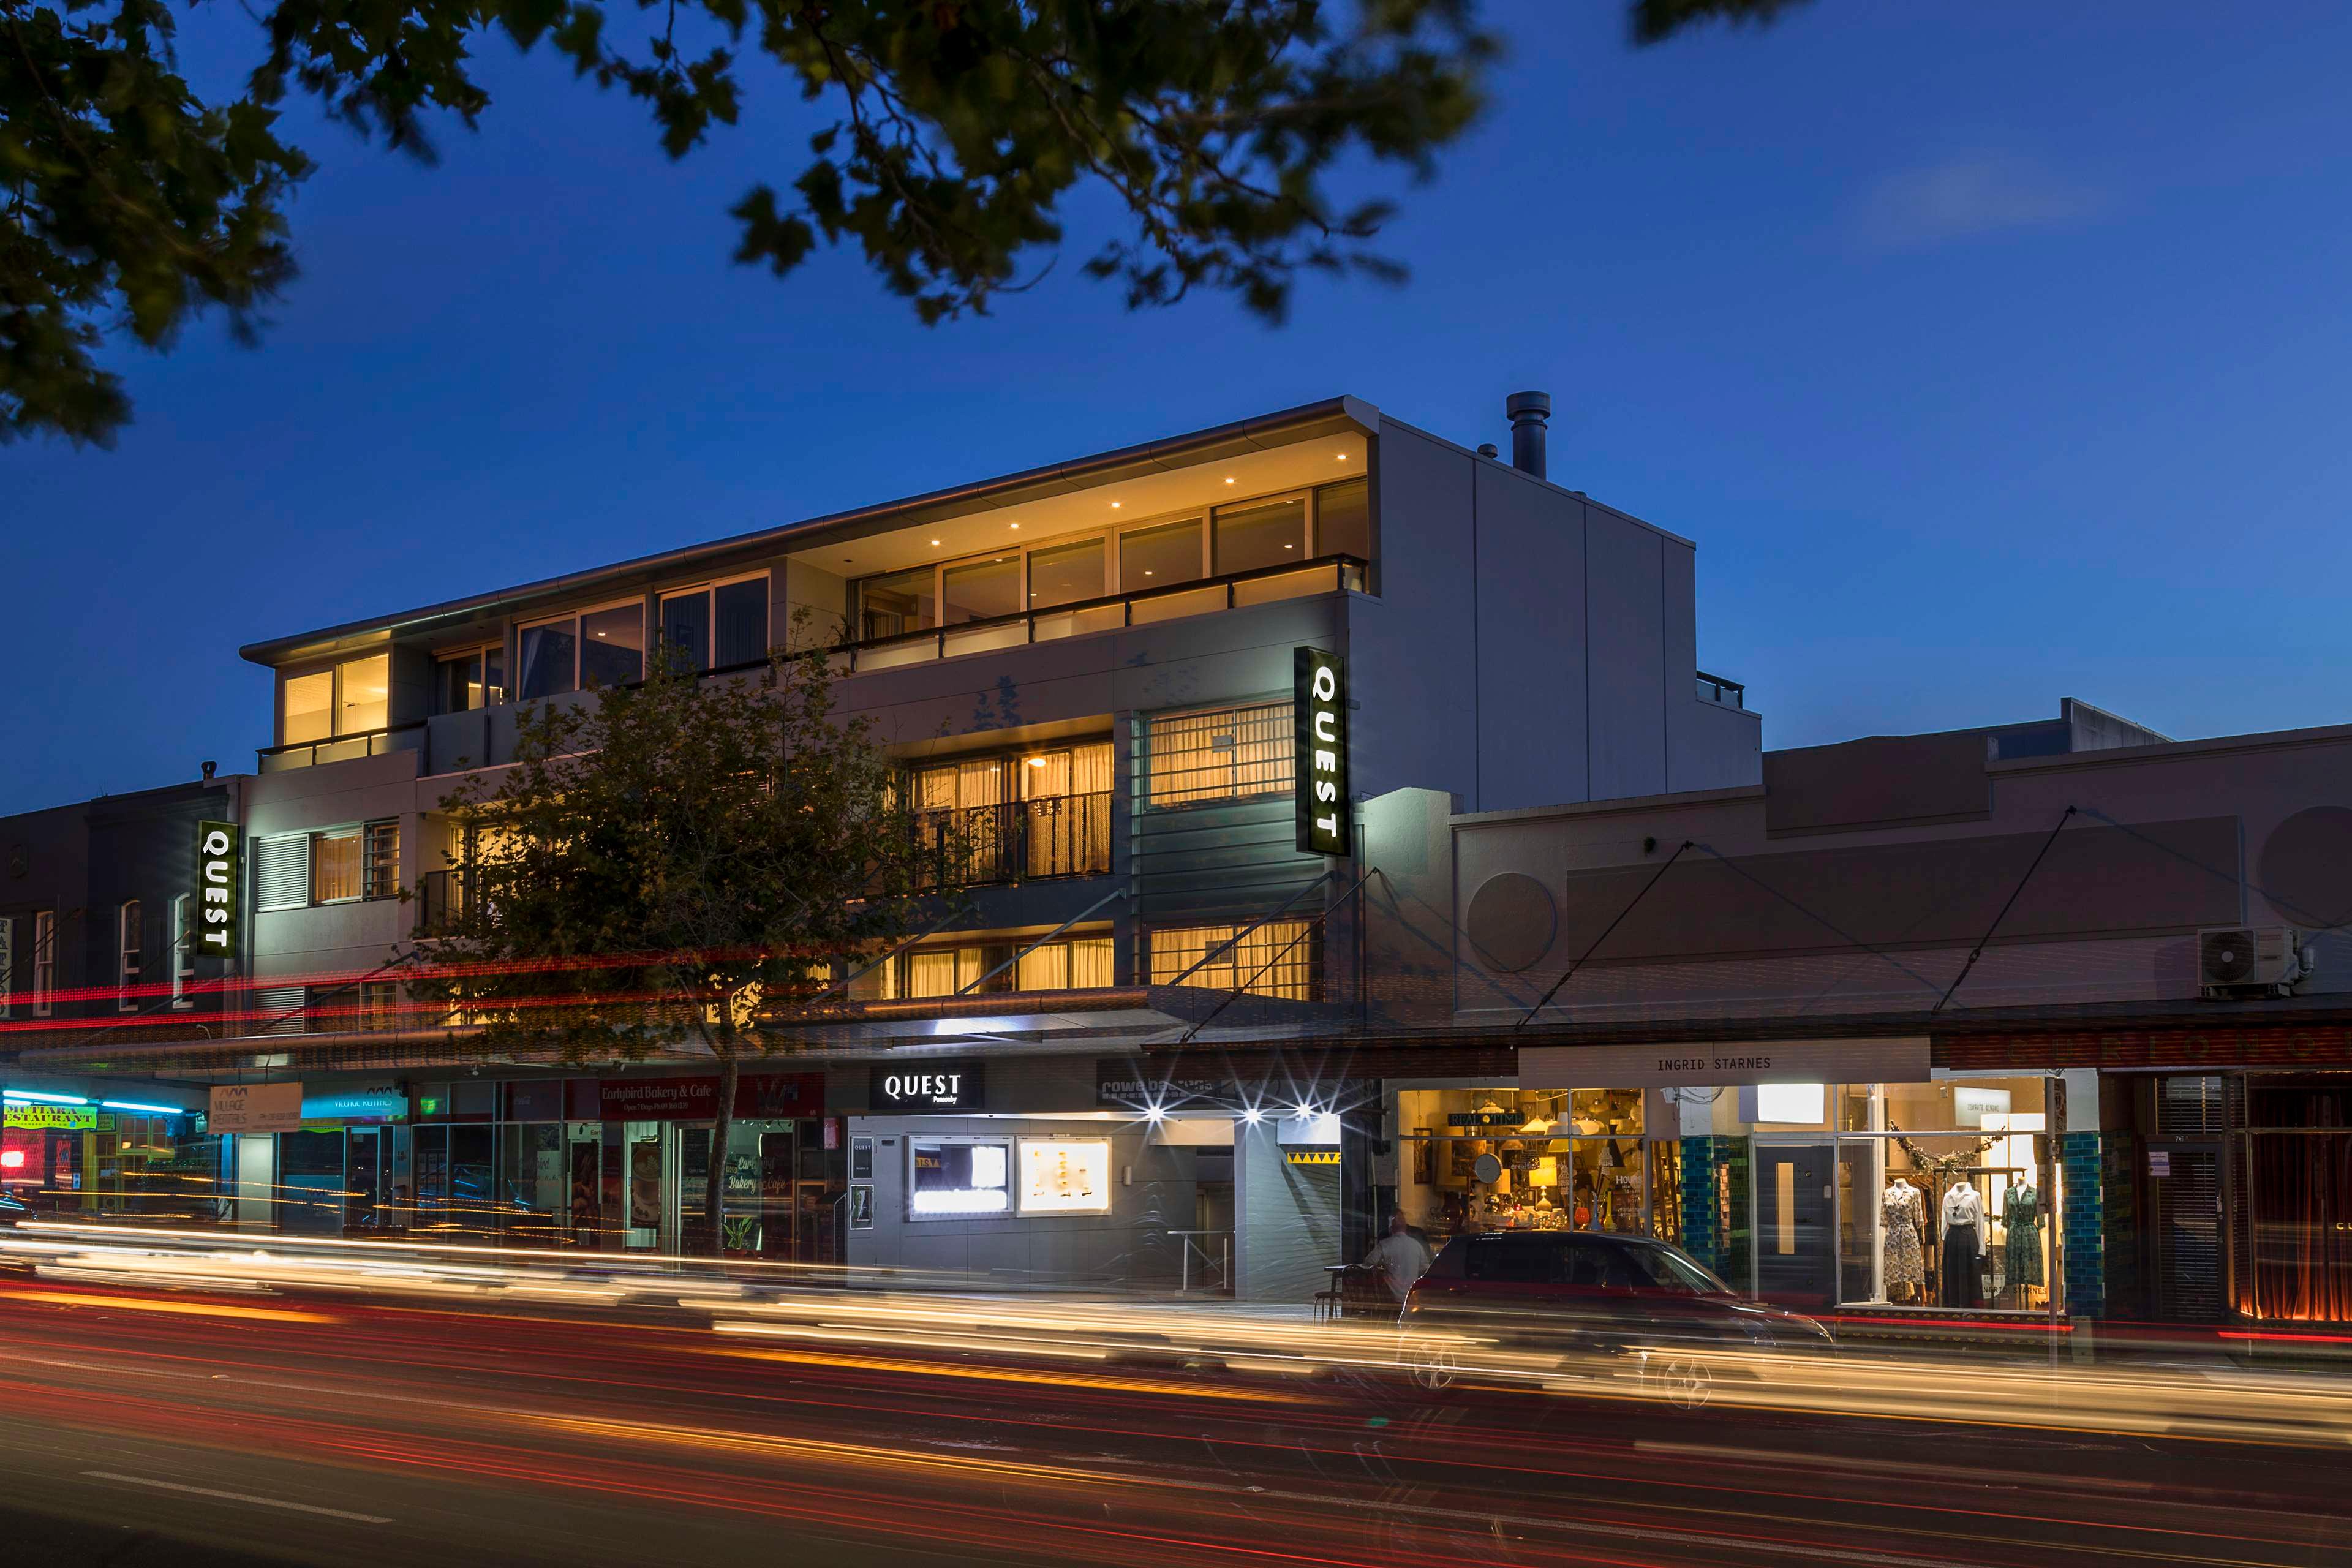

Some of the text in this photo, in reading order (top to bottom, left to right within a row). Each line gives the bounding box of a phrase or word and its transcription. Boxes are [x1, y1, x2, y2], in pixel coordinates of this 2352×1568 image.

[1312, 666, 1336, 838] QUEST
[203, 831, 229, 948] QUEST
[1658, 1058, 1771, 1071] INGRID STARNES
[602, 1084, 712, 1102] Earlybird Bakery & Cafe
[884, 1074, 961, 1100] QUEST
[7, 1106, 77, 1114] MUTIARA
[214, 1099, 245, 1111] VILLAGE
[3, 1114, 92, 1123] ESTAURANT
[1452, 1114, 1523, 1125] REAL TIME
[728, 1175, 756, 1195] Bakery
